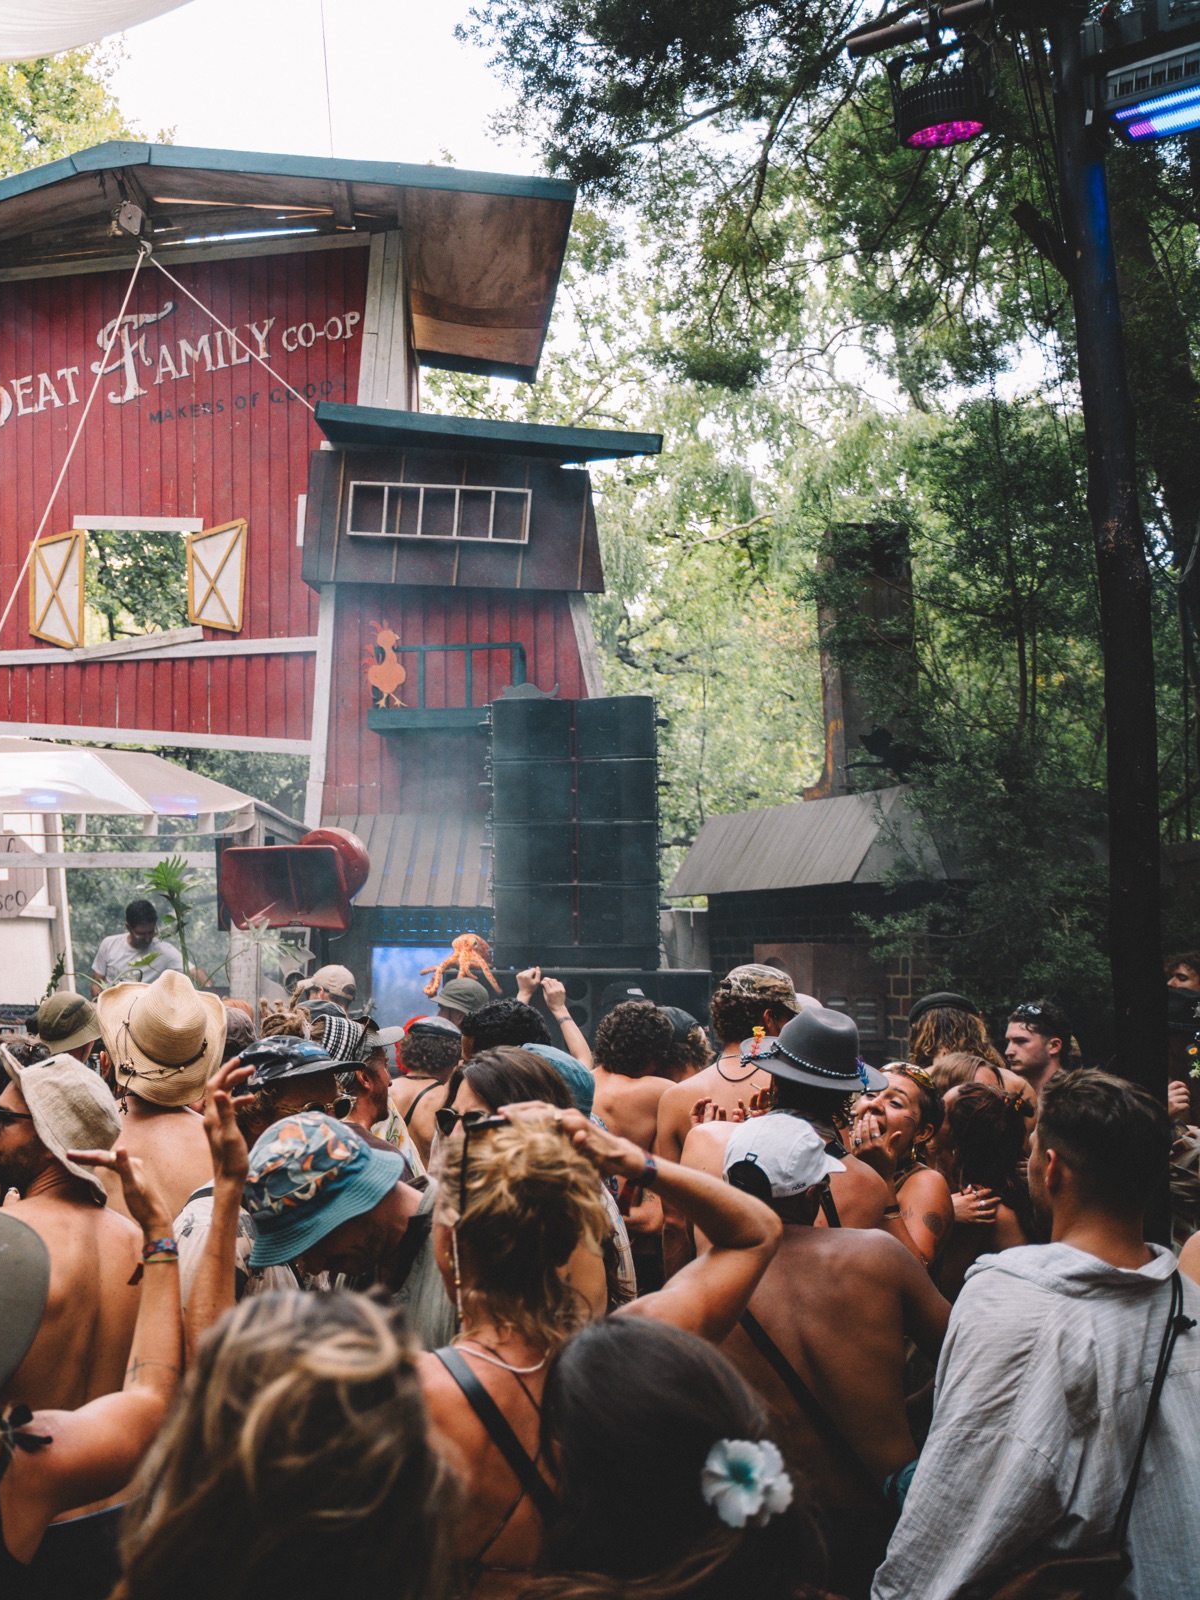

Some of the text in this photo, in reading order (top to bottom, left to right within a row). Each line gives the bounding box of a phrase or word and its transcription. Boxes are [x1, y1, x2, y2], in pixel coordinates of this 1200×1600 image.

[90, 301, 276, 405] FAMILY
[281, 311, 361, 352] CO-OP
[149, 399, 225, 425] MAKERS
[235, 392, 260, 410] OF
